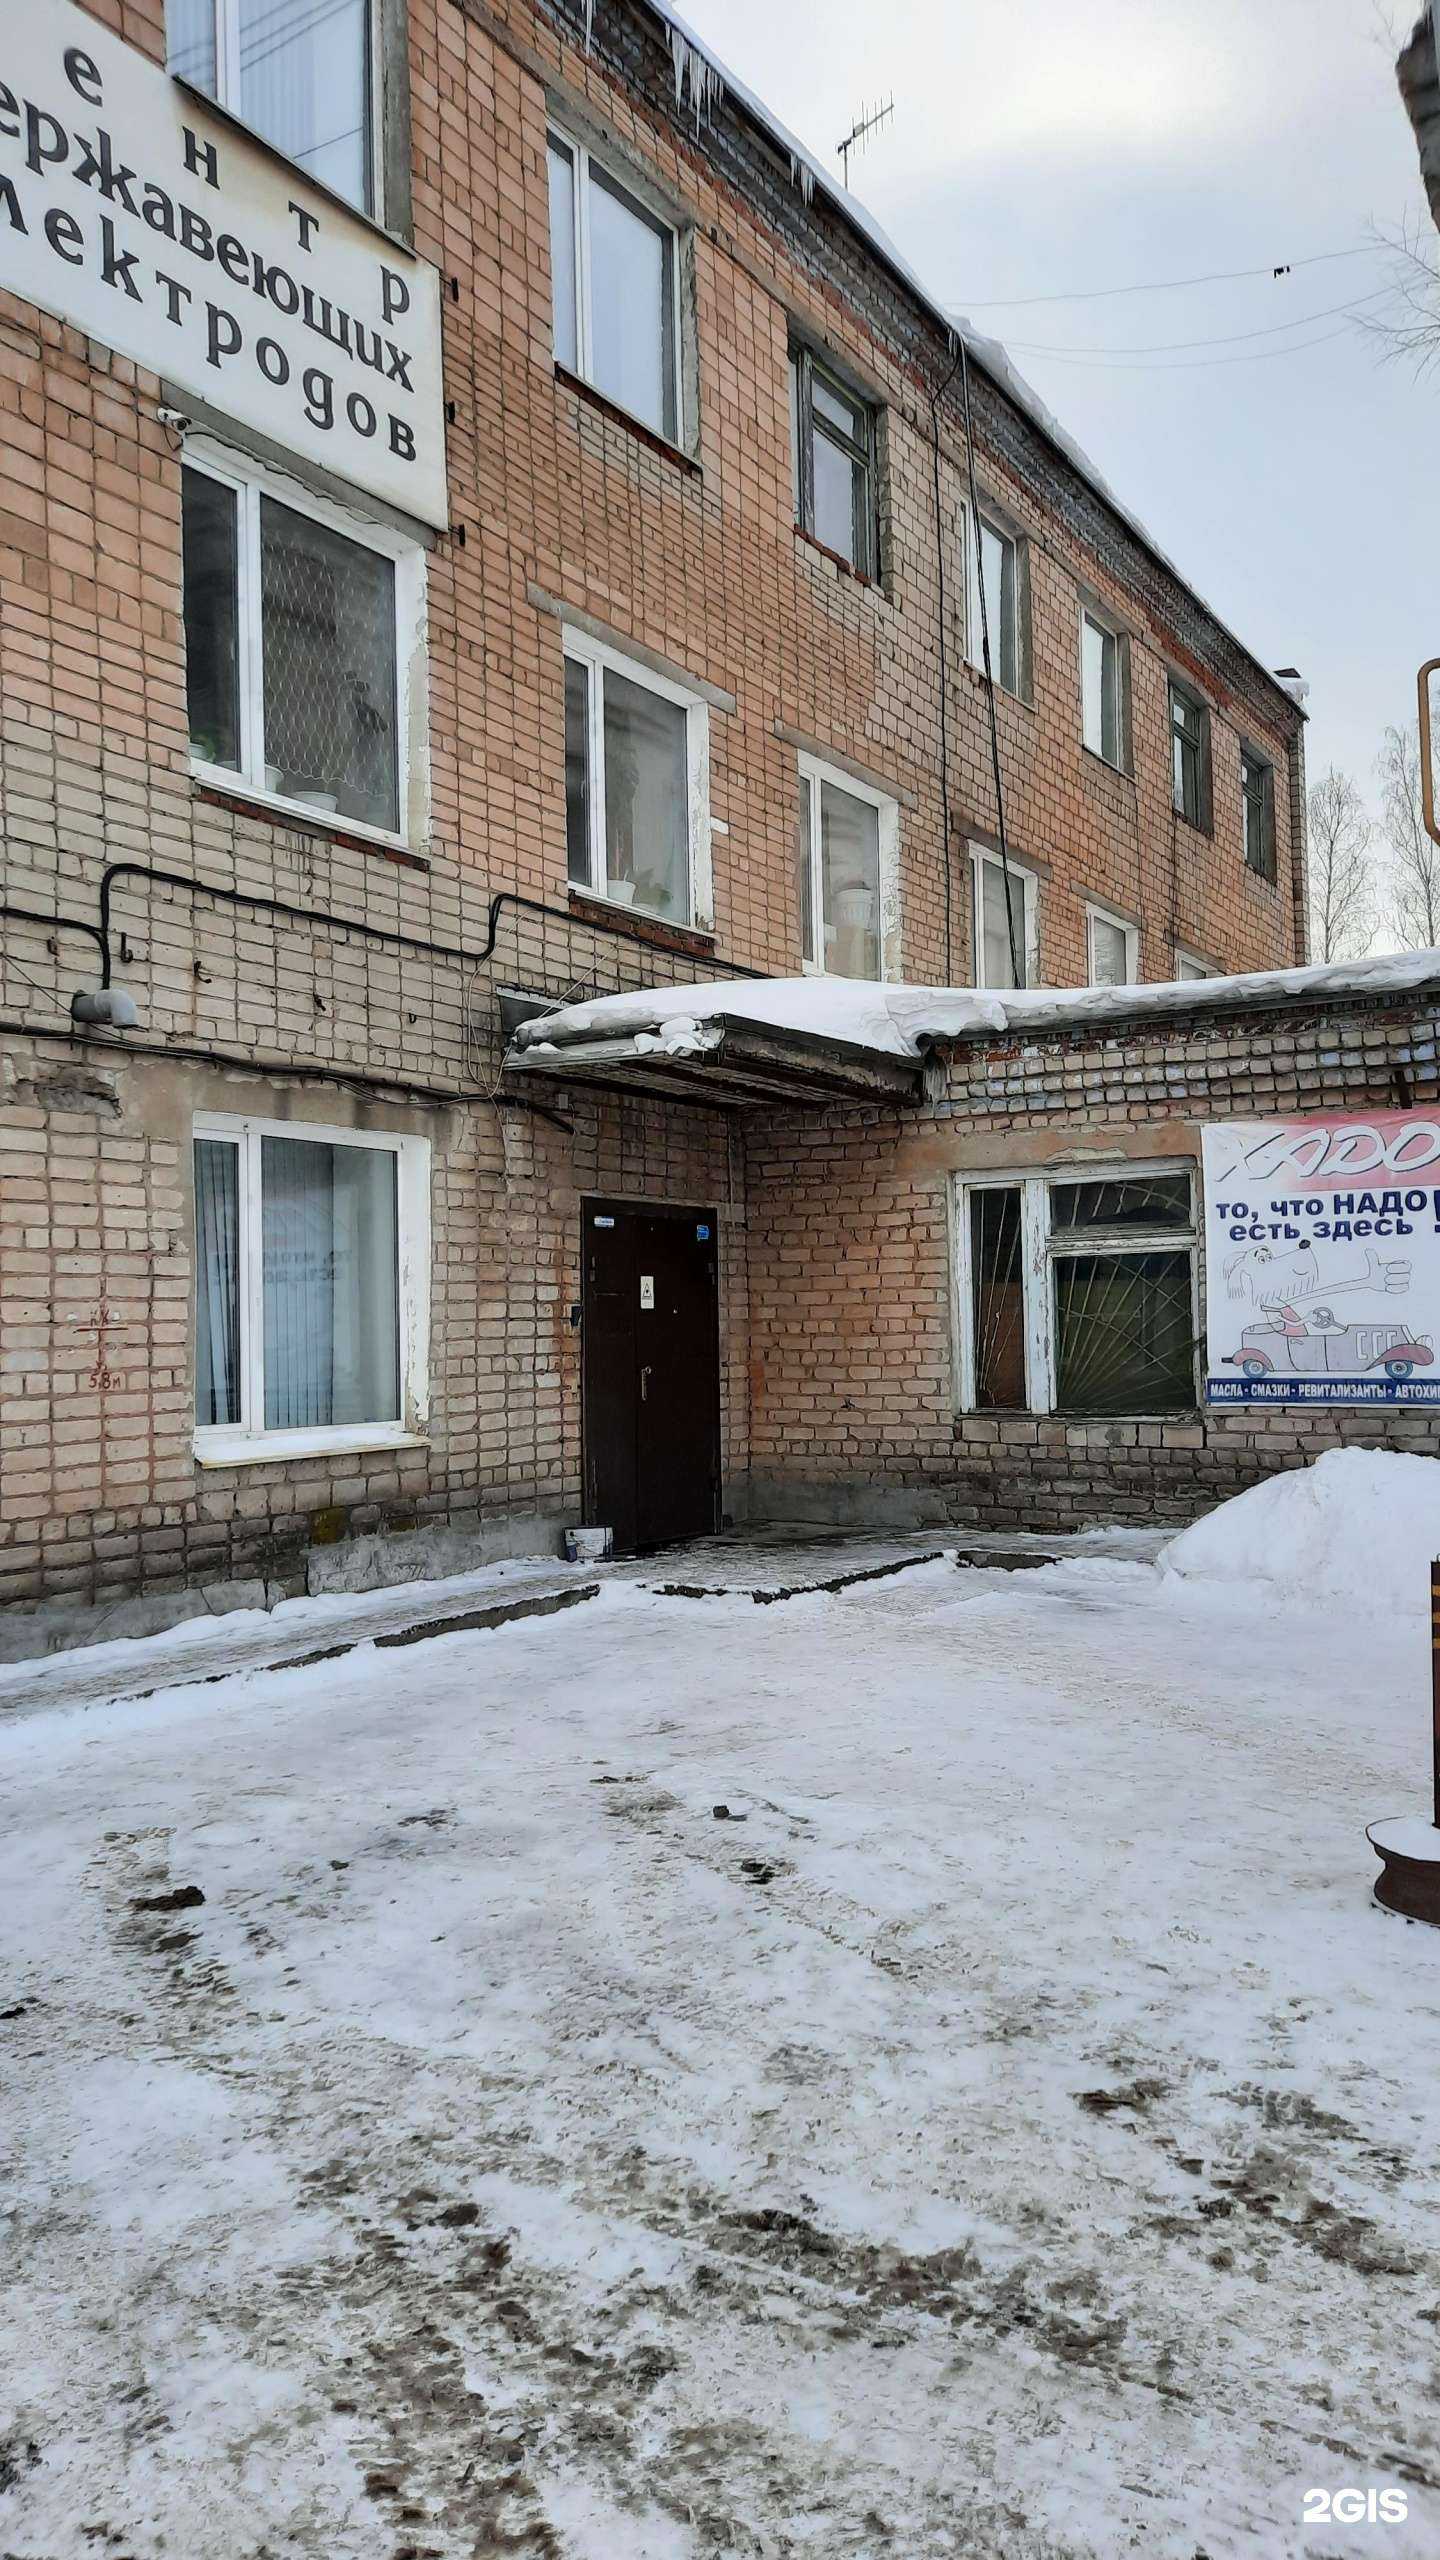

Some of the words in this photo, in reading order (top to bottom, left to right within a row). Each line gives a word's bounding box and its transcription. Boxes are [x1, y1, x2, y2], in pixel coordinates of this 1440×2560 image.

[1216, 1202, 1259, 1223] то,
[1271, 1199, 1324, 1217] что
[1333, 1189, 1428, 1217] НАДО
[1229, 1222, 1301, 1241] есть
[1313, 1217, 1414, 1241] здесь
[1210, 1383, 1243, 1397] МАСЛА
[1251, 1383, 1290, 1397] СМАЗКИ
[1298, 1383, 1386, 1398] РЕВИТАЛИЗАНТЫ
[1395, 1384, 1440, 1399] АВТОХИ
